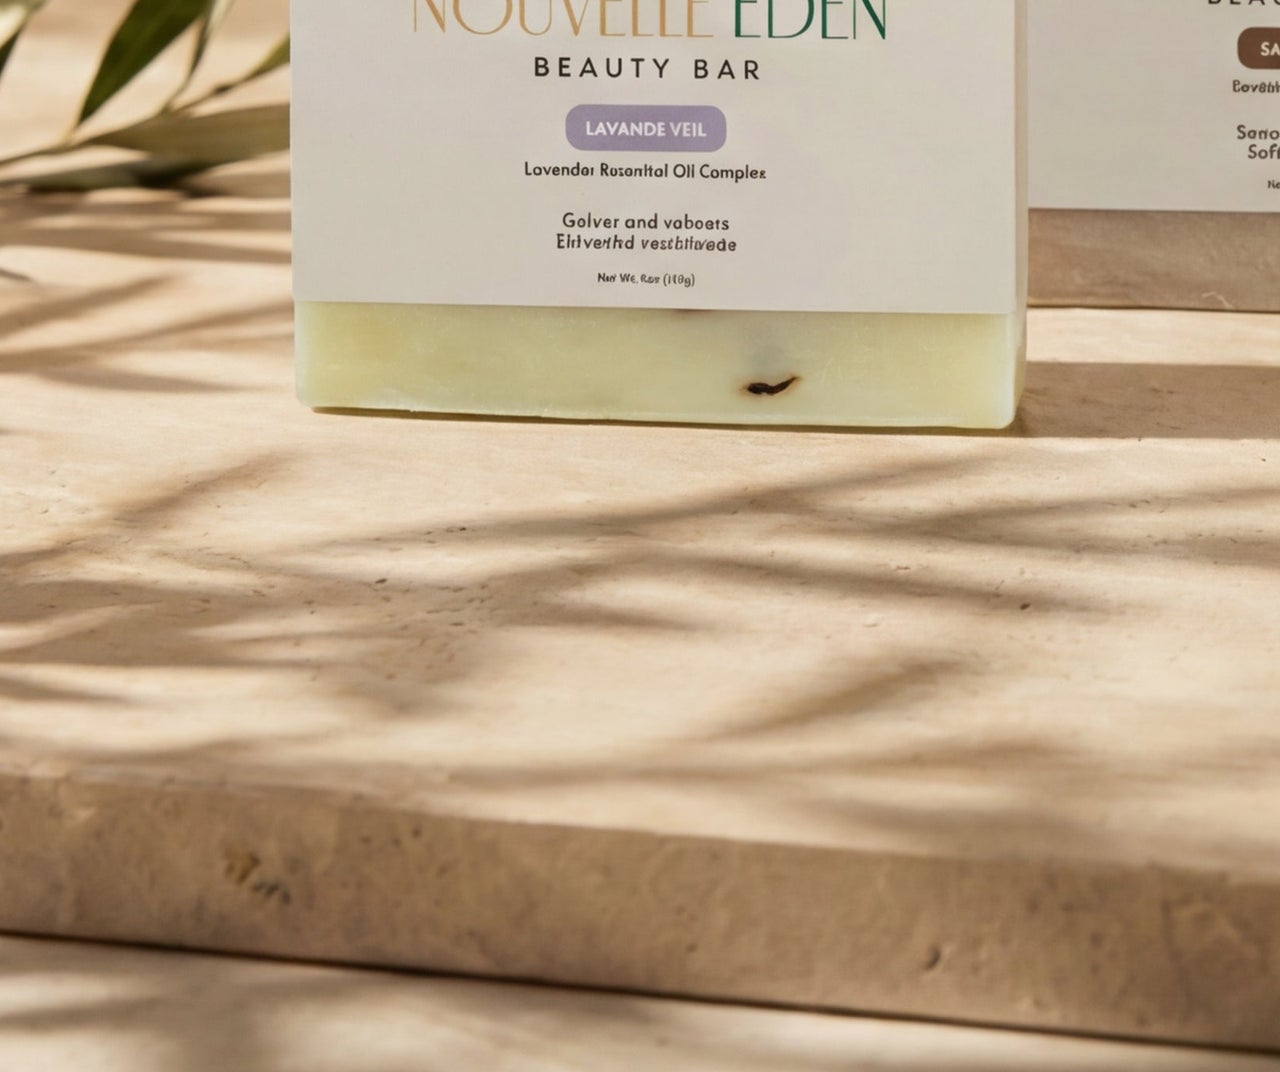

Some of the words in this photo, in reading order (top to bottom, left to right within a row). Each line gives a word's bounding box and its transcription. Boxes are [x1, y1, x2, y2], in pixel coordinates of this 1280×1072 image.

[534, 56, 671, 79] BEAUTY
[693, 59, 760, 81] BAR
[586, 121, 666, 137] LAVANDE
[669, 122, 707, 137] VEIL
[625, 213, 658, 229] and
